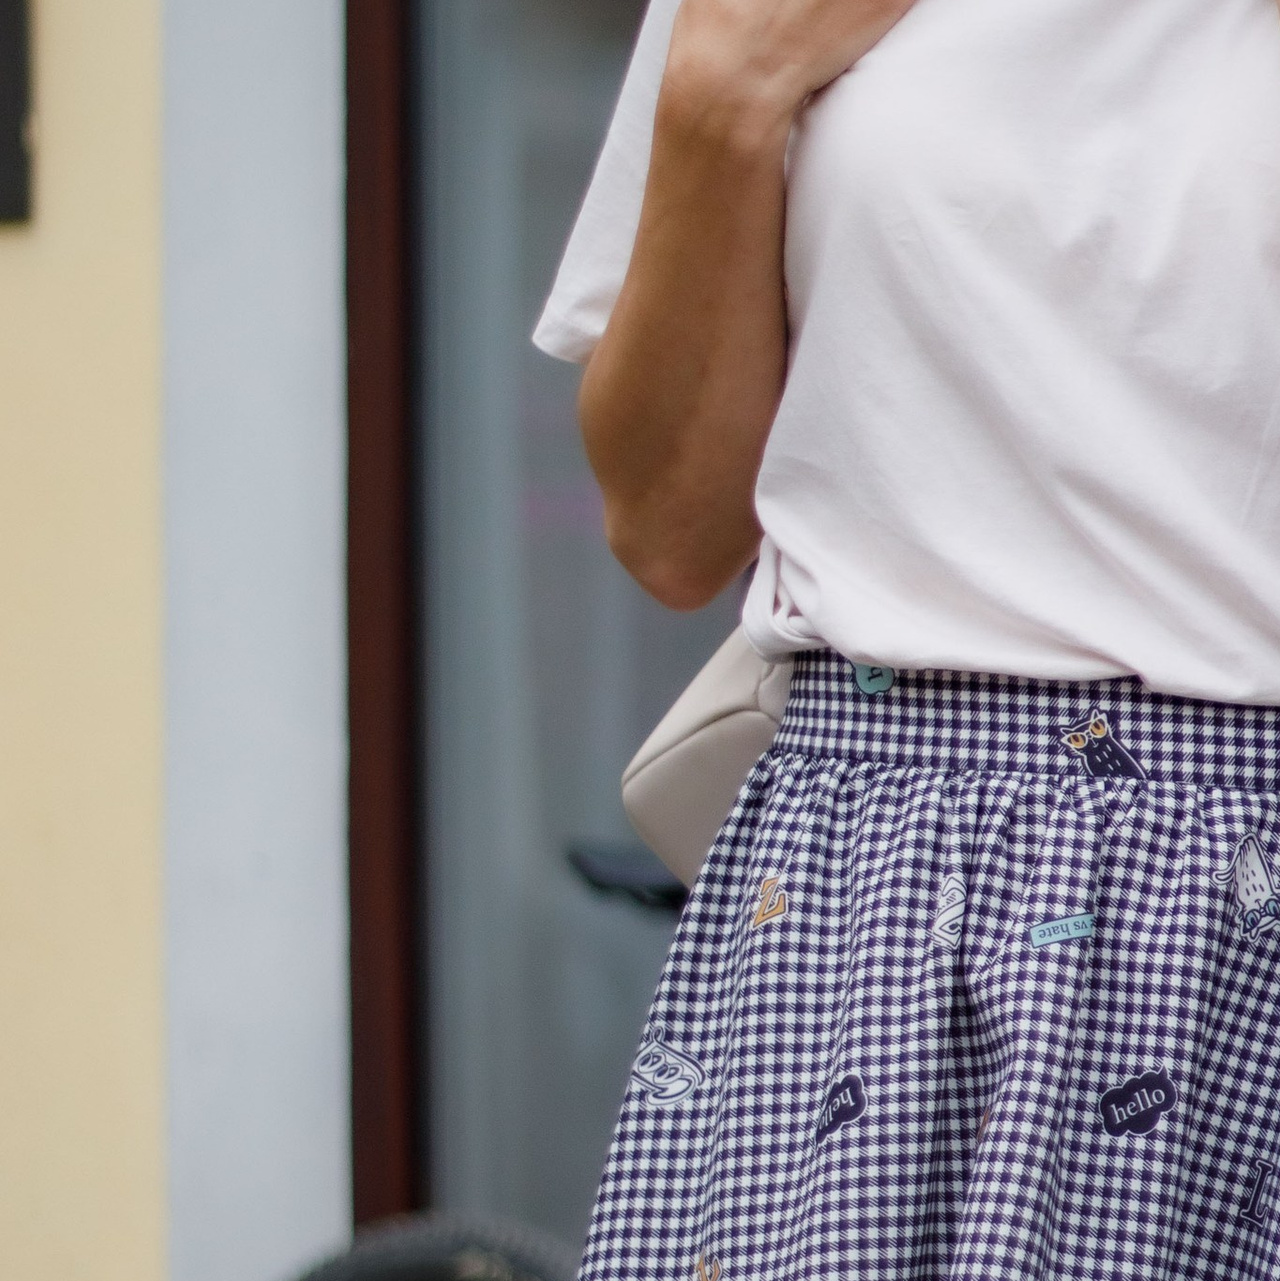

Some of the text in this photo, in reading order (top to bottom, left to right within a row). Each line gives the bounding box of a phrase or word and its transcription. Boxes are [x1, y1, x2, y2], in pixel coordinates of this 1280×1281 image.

[1038, 920, 1088, 939] vs hate
[1110, 1087, 1165, 1125] hello
